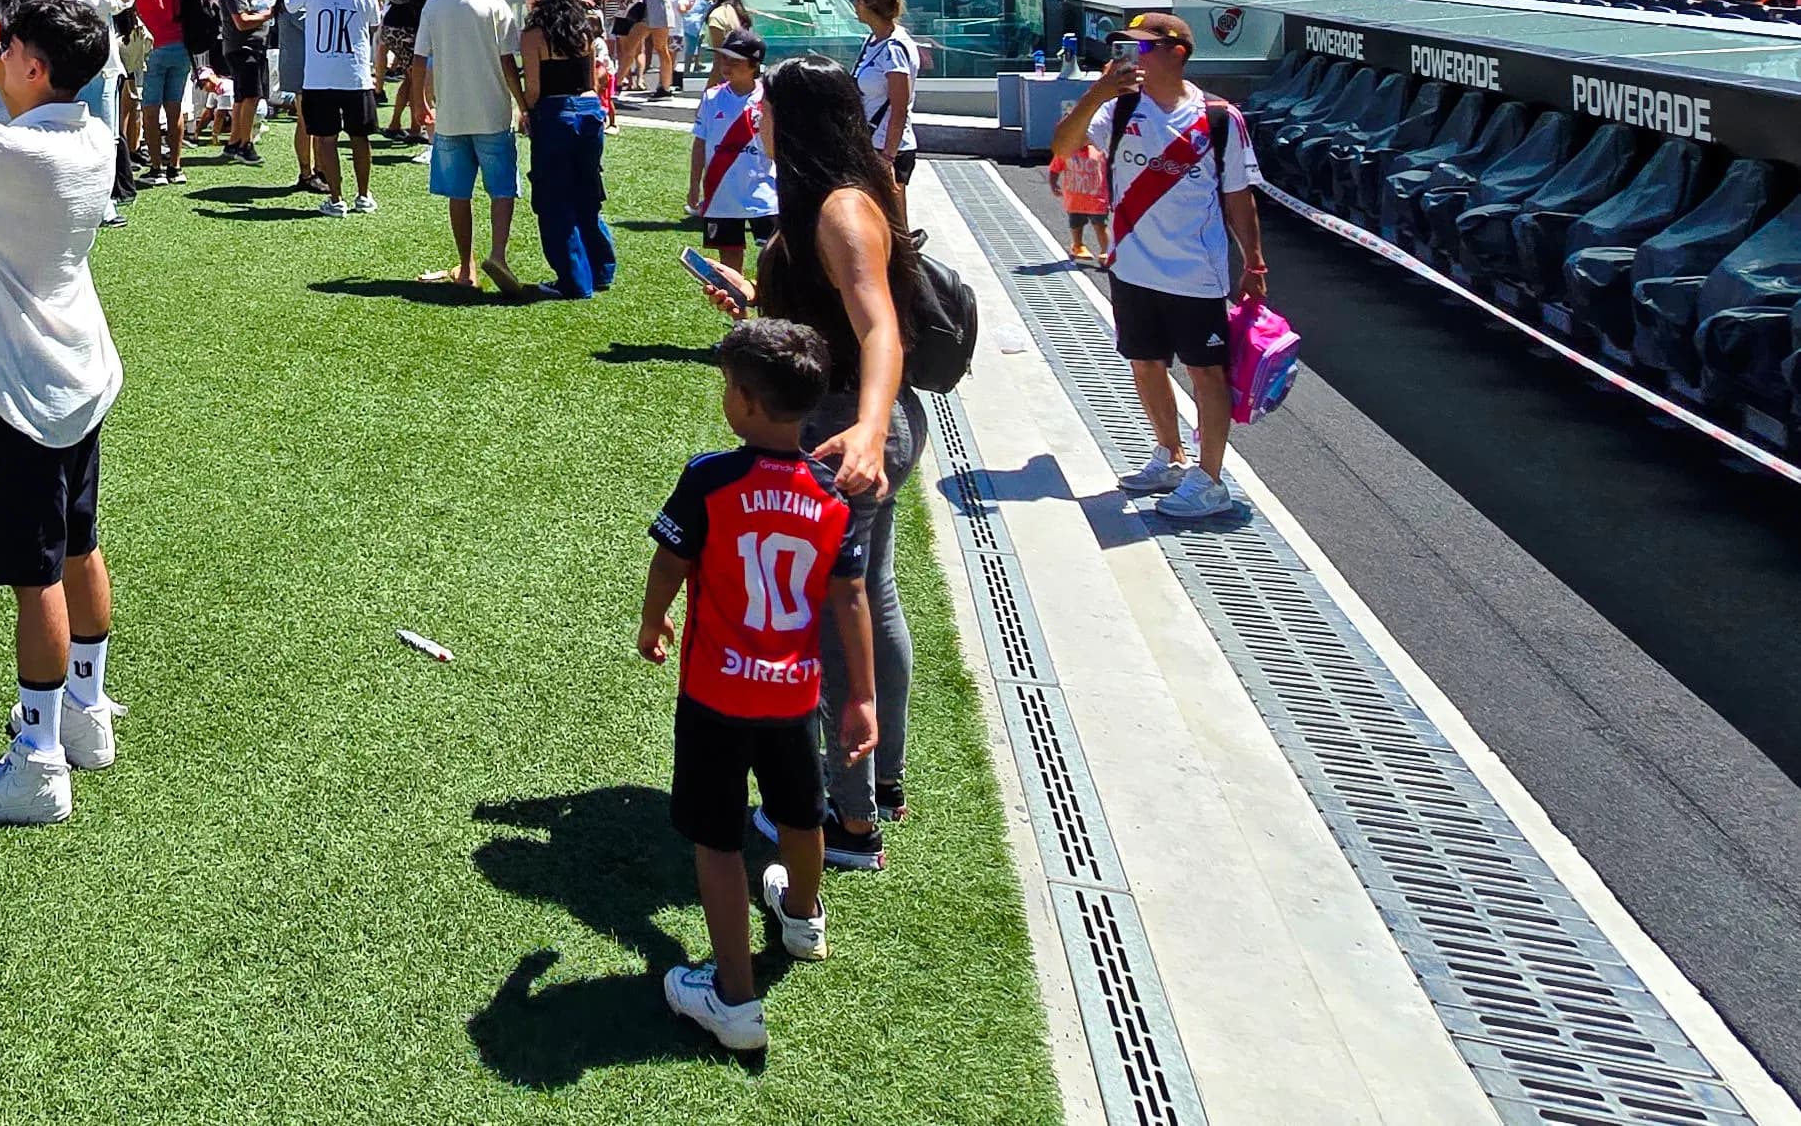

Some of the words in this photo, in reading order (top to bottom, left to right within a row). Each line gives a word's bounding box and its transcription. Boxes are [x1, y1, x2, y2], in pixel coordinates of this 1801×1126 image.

[316, 8, 357, 54] OK
[1306, 25, 1365, 61] POWERADE
[1411, 44, 1501, 91] POWERADE
[1572, 74, 1712, 142] POWERADE
[759, 460, 794, 473] Grande
[740, 489, 823, 522] LANZINI
[737, 532, 818, 631] 10
